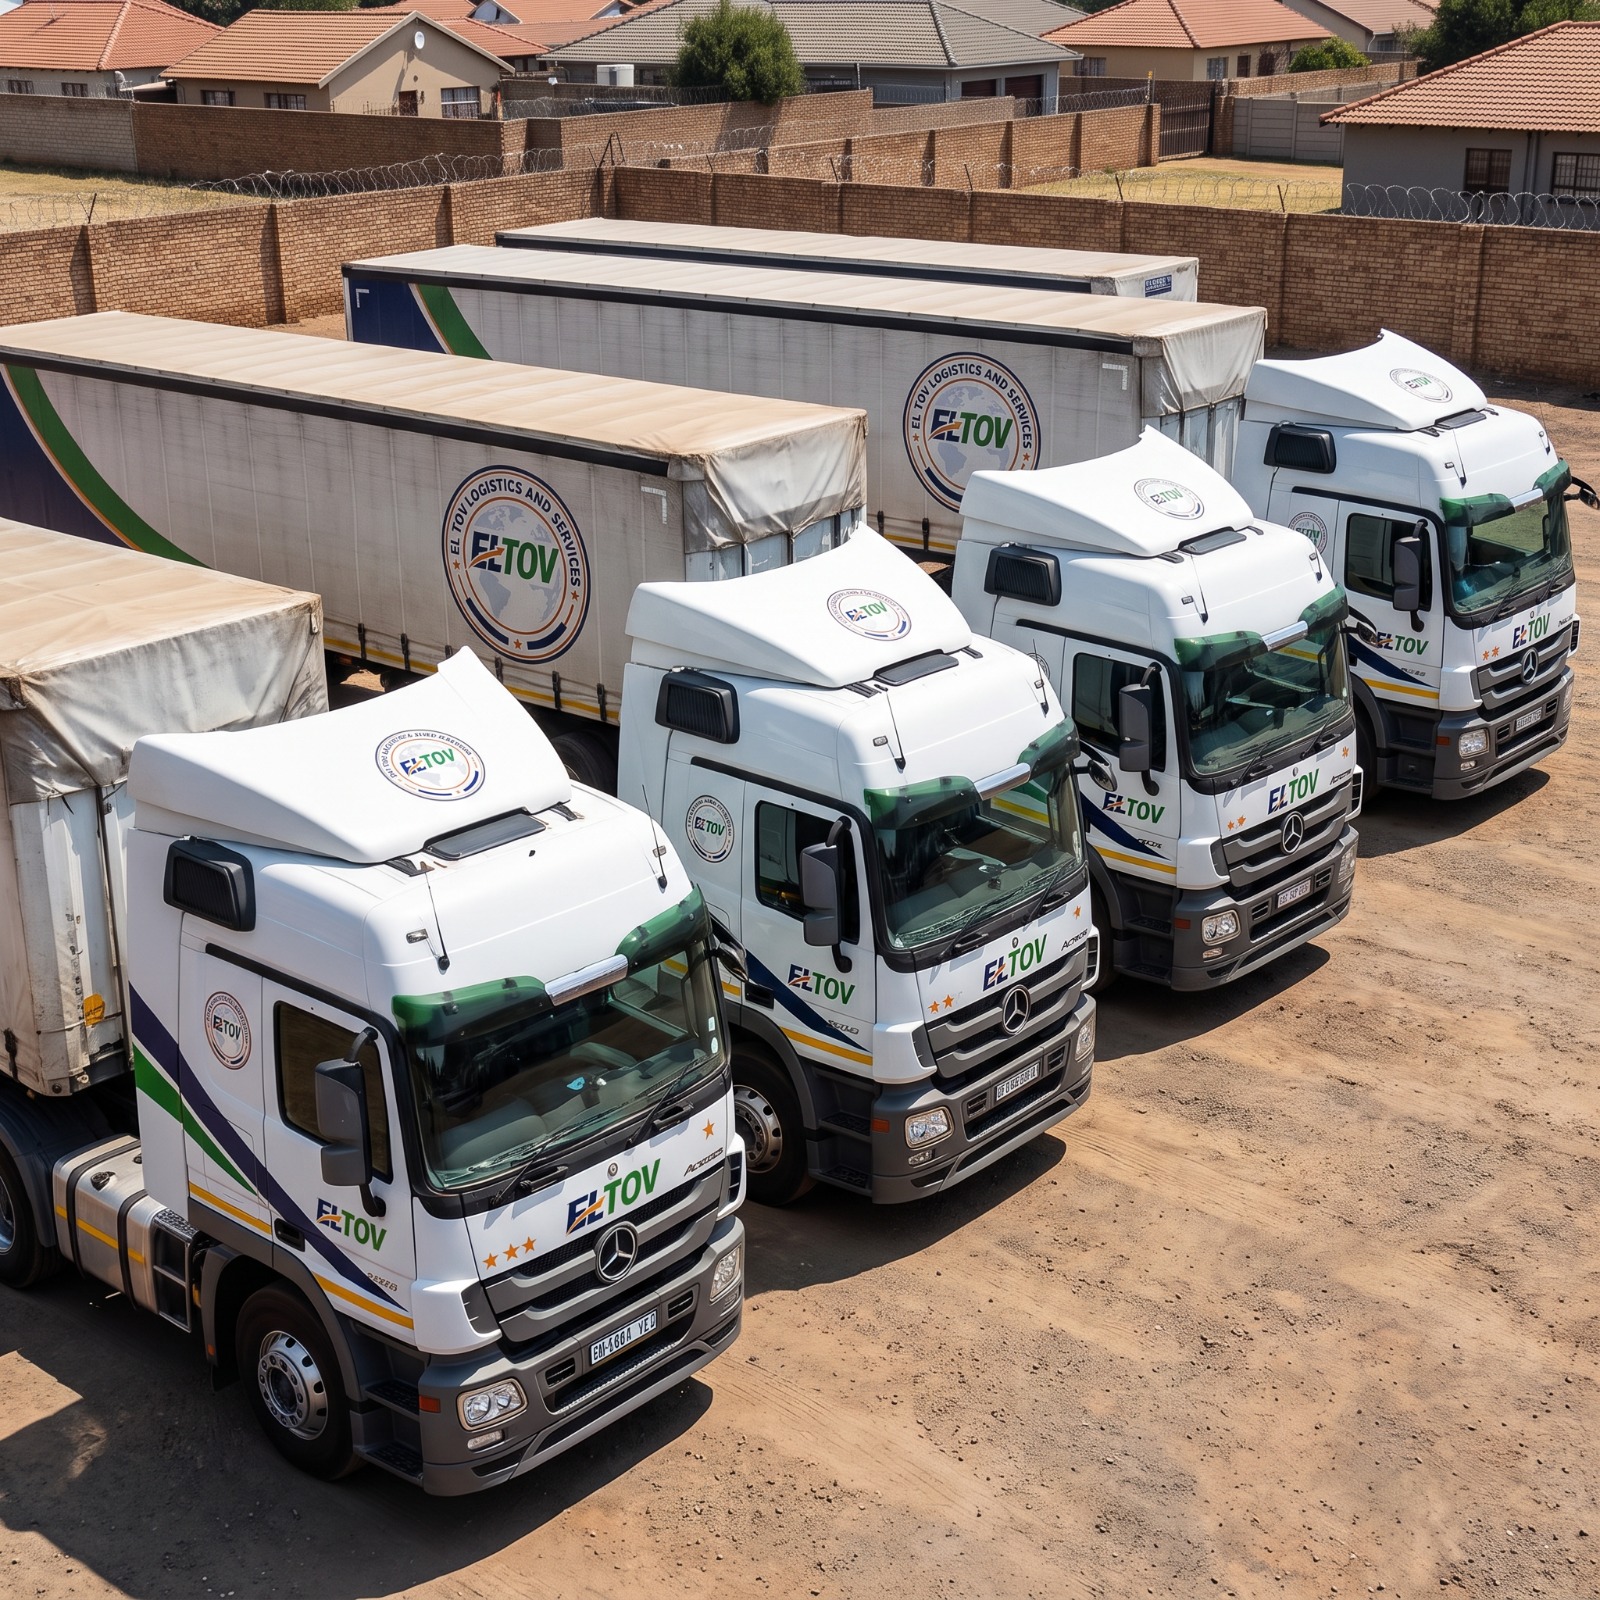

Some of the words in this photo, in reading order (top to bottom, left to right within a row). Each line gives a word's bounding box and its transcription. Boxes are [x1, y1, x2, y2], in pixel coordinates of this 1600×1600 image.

[928, 363, 982, 388] LOGISTICS
[984, 368, 1008, 390] AND
[914, 385, 930, 410] TOV
[912, 414, 921, 430] EL
[1007, 388, 1032, 449] SERVICES
[464, 478, 523, 507] LOGISTICS
[525, 487, 552, 513] AND
[452, 503, 468, 532] TOV
[451, 537, 460, 555] EL
[551, 513, 580, 587] SERVICES
